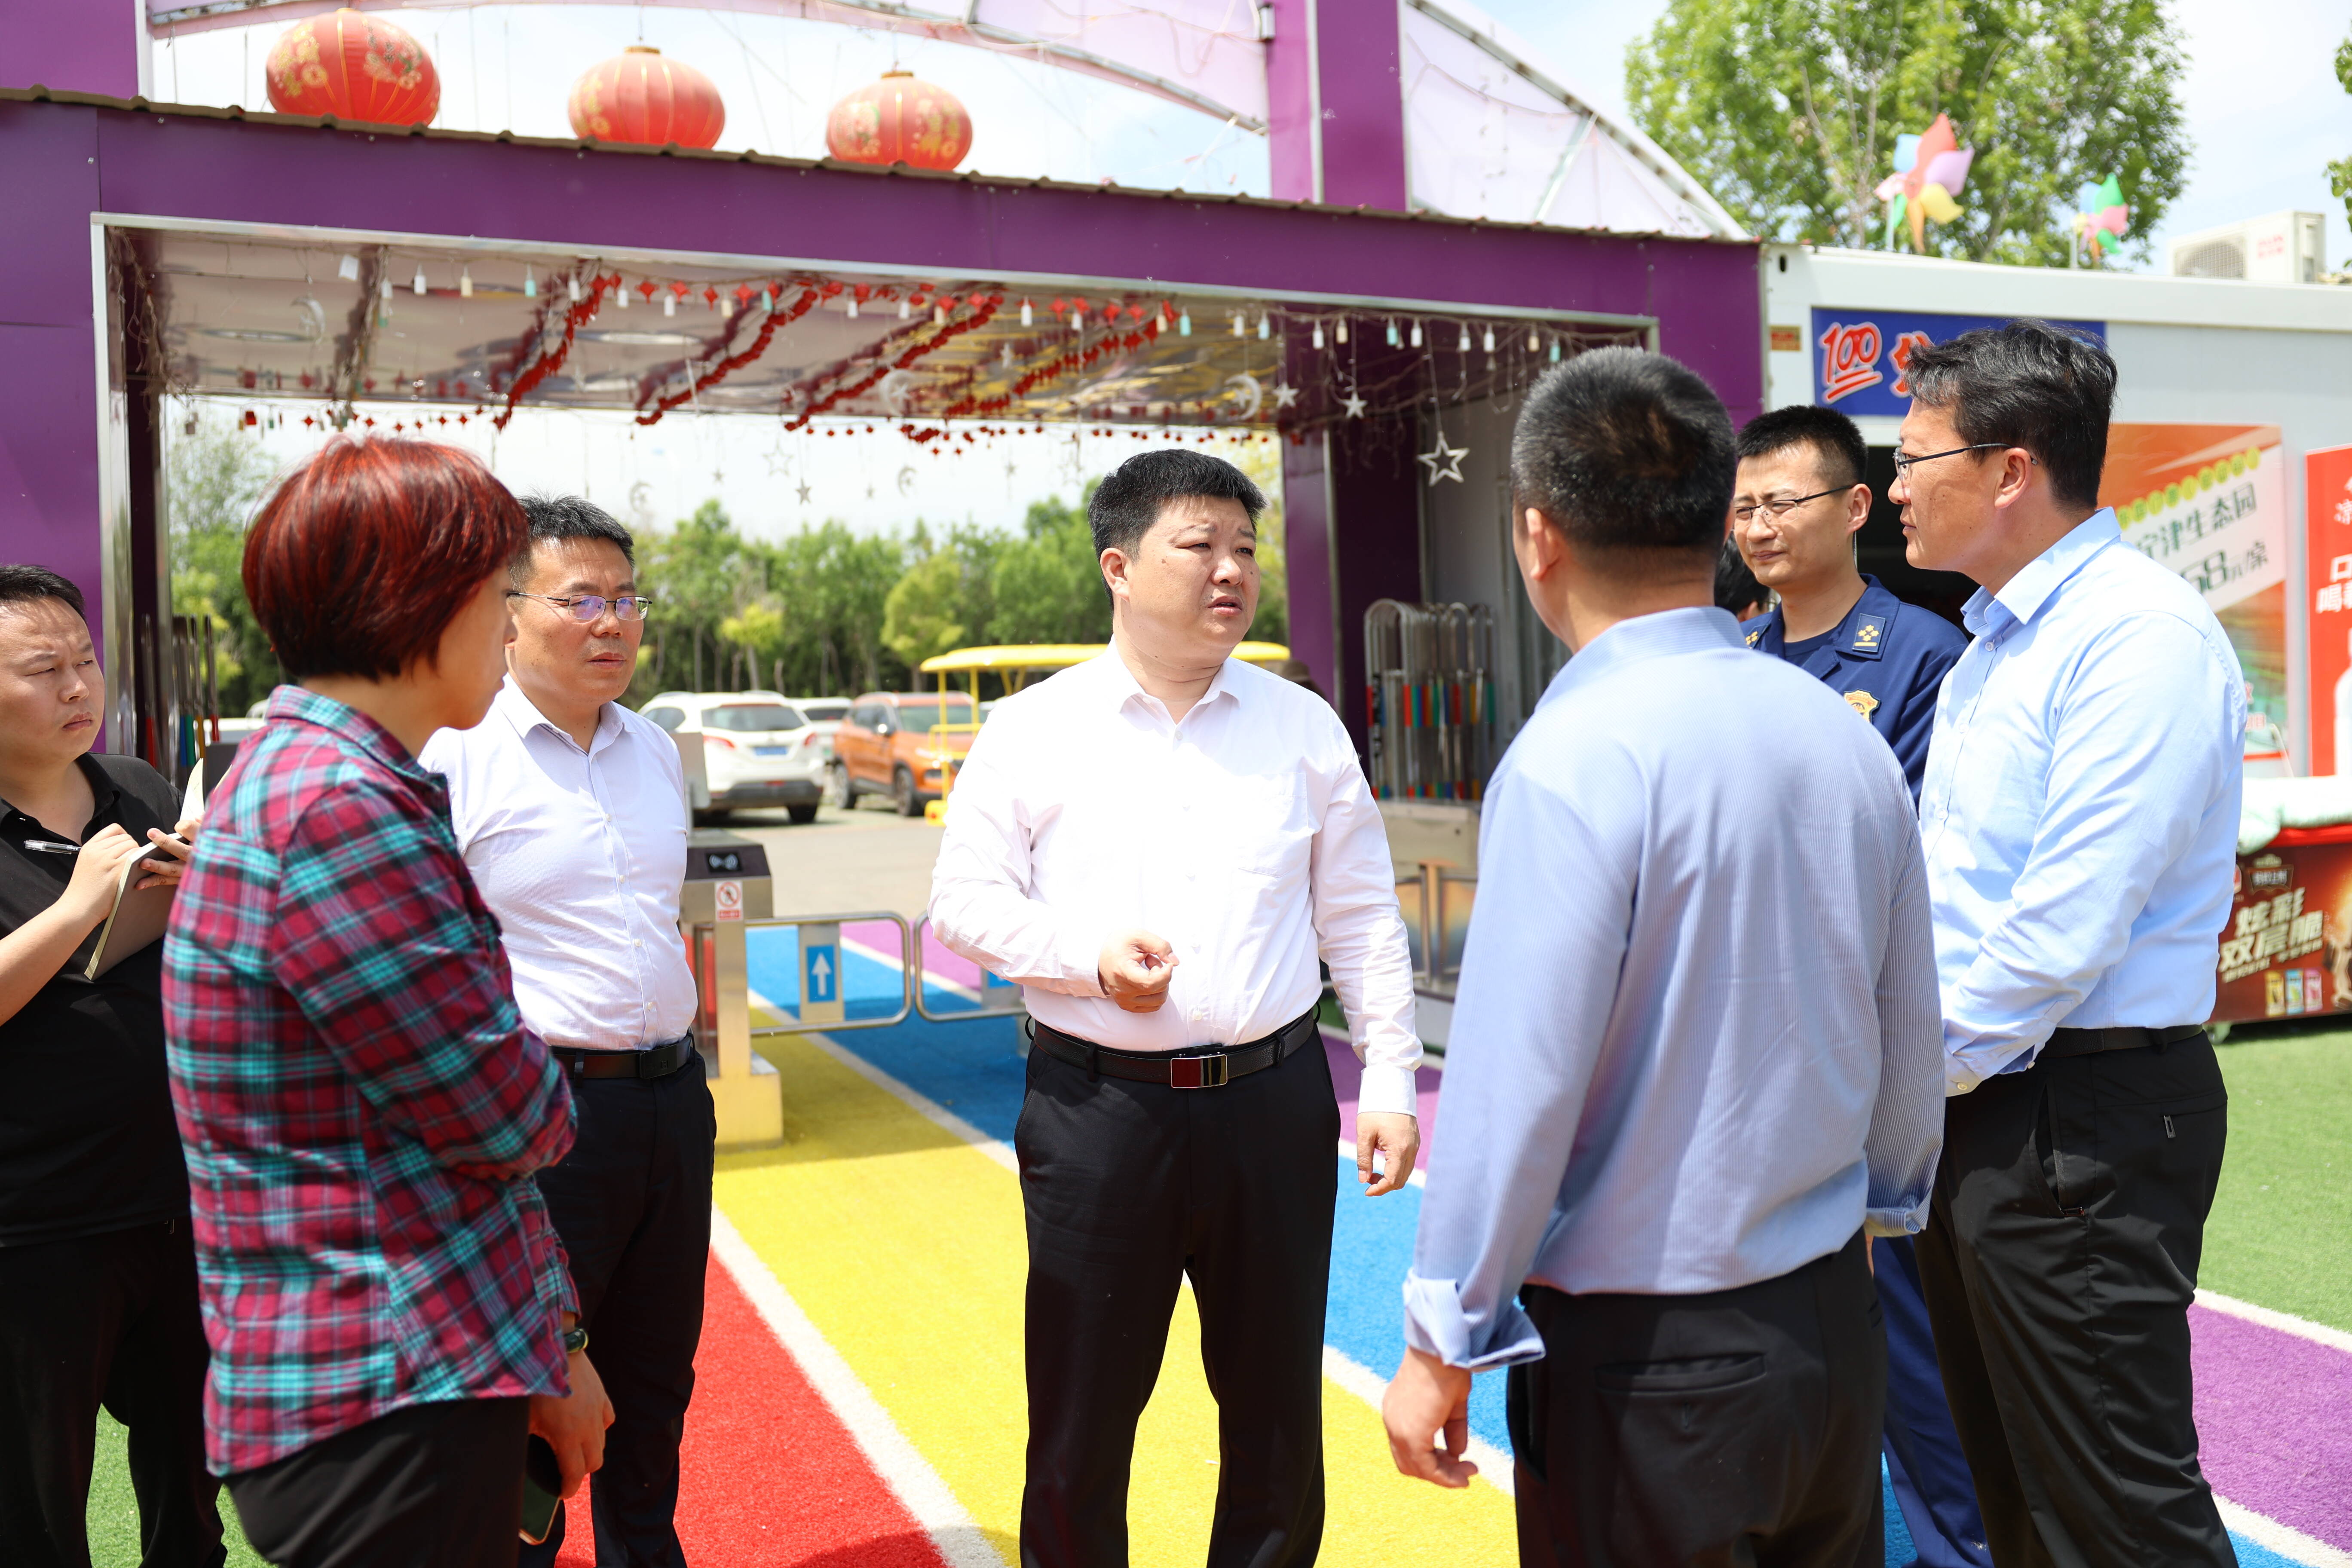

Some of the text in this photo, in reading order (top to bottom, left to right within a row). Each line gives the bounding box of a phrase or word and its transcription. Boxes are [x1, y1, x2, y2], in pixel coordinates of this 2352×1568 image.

[2235, 887, 2305, 938] 炫彩
[2219, 910, 2323, 972] 双层脆
